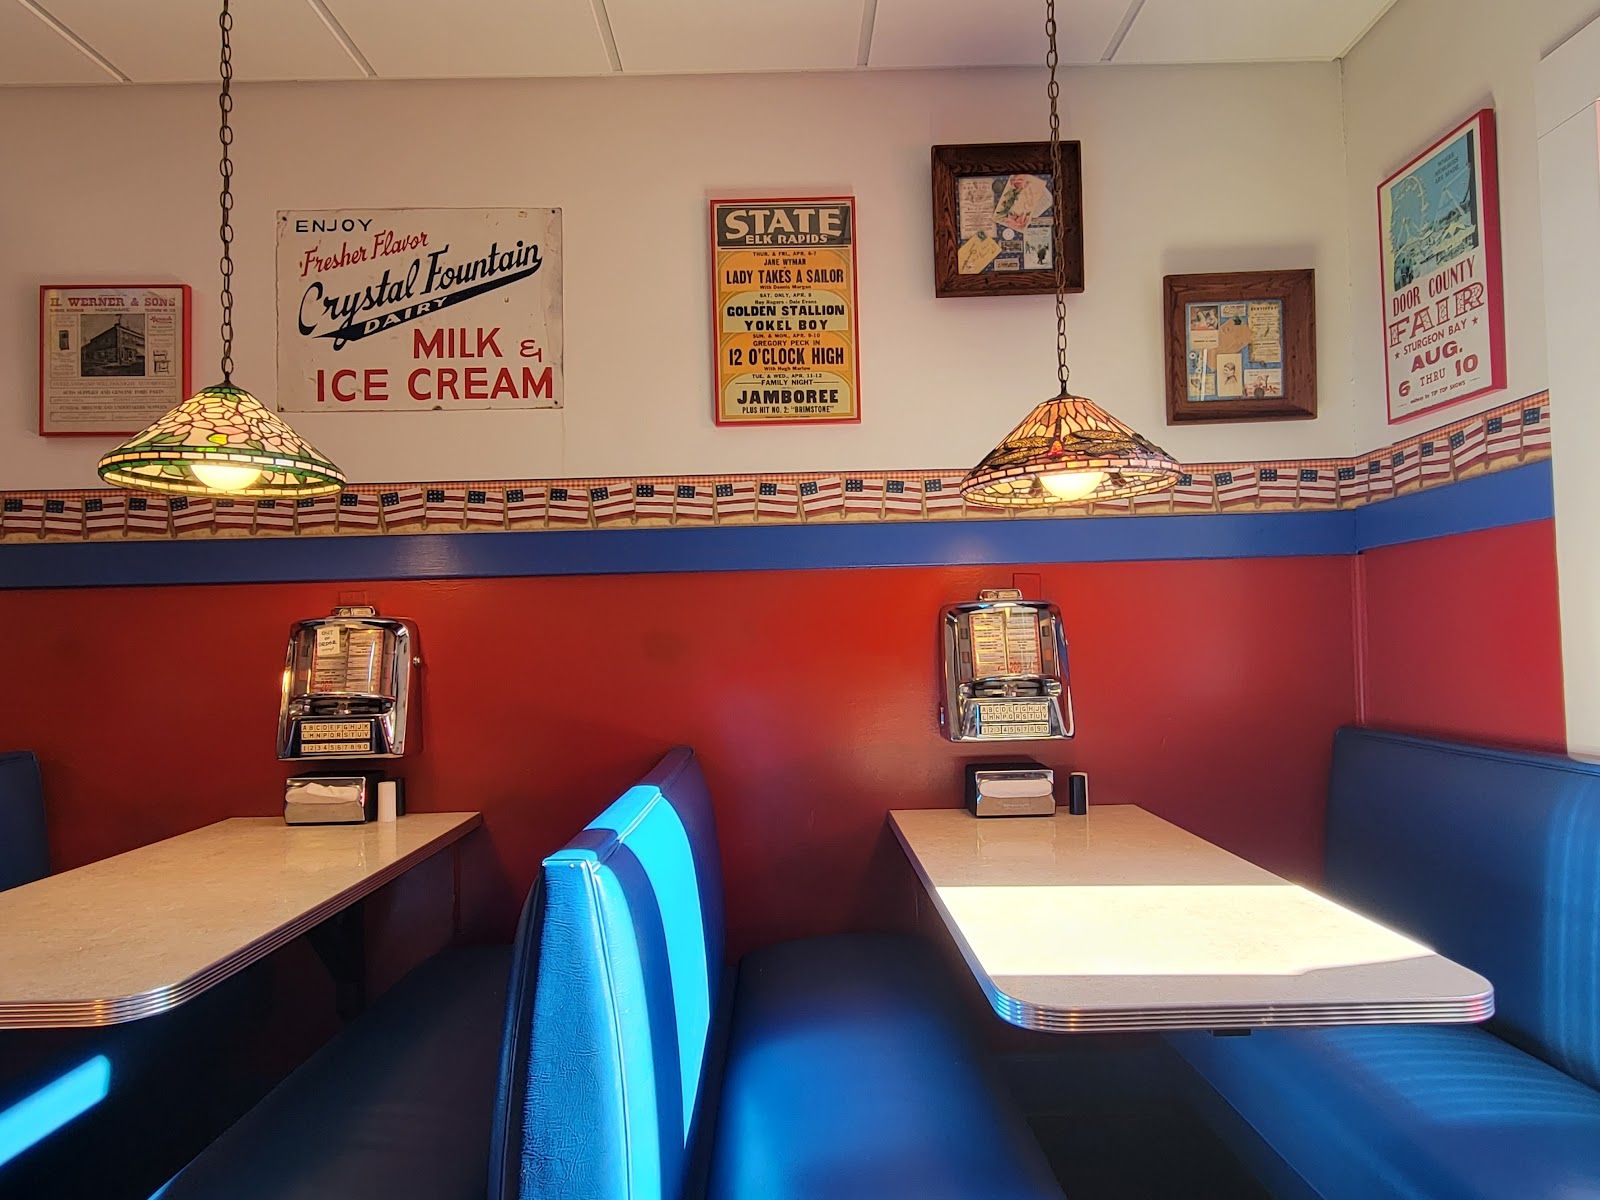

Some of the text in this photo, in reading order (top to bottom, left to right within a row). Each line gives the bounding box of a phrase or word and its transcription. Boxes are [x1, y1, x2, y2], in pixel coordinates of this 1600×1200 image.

[295, 219, 373, 232] ENJOY
[725, 208, 841, 239] STATE
[745, 234, 828, 244] ELK RAPIDS
[301, 230, 431, 277] Fresher Flavor
[726, 269, 844, 284] LADY TAKES A SAILOR
[1393, 255, 1476, 317] DOOR COUNTY
[68, 297, 125, 307] WERNER
[130, 298, 139, 306] &
[144, 297, 176, 306] SONS
[298, 240, 543, 351] Crystal Fountain
[727, 305, 845, 317] GOLDEN STALLION
[364, 296, 448, 335] DAIRY
[744, 319, 828, 331] YOKEL BOY
[1389, 282, 1484, 348] FAIR
[413, 327, 542, 363] MILK &
[1403, 319, 1467, 356] STURGEON BAY
[729, 347, 844, 366] 12 O'CLOCK HIGH
[1411, 340, 1463, 373] AUG.
[316, 366, 553, 402] ICE CREAM
[1398, 354, 1478, 397] 6 THRU 10
[737, 390, 839, 405] JAMBOREE
[742, 406, 757, 414] PLUS
[759, 406, 769, 414] HIT
